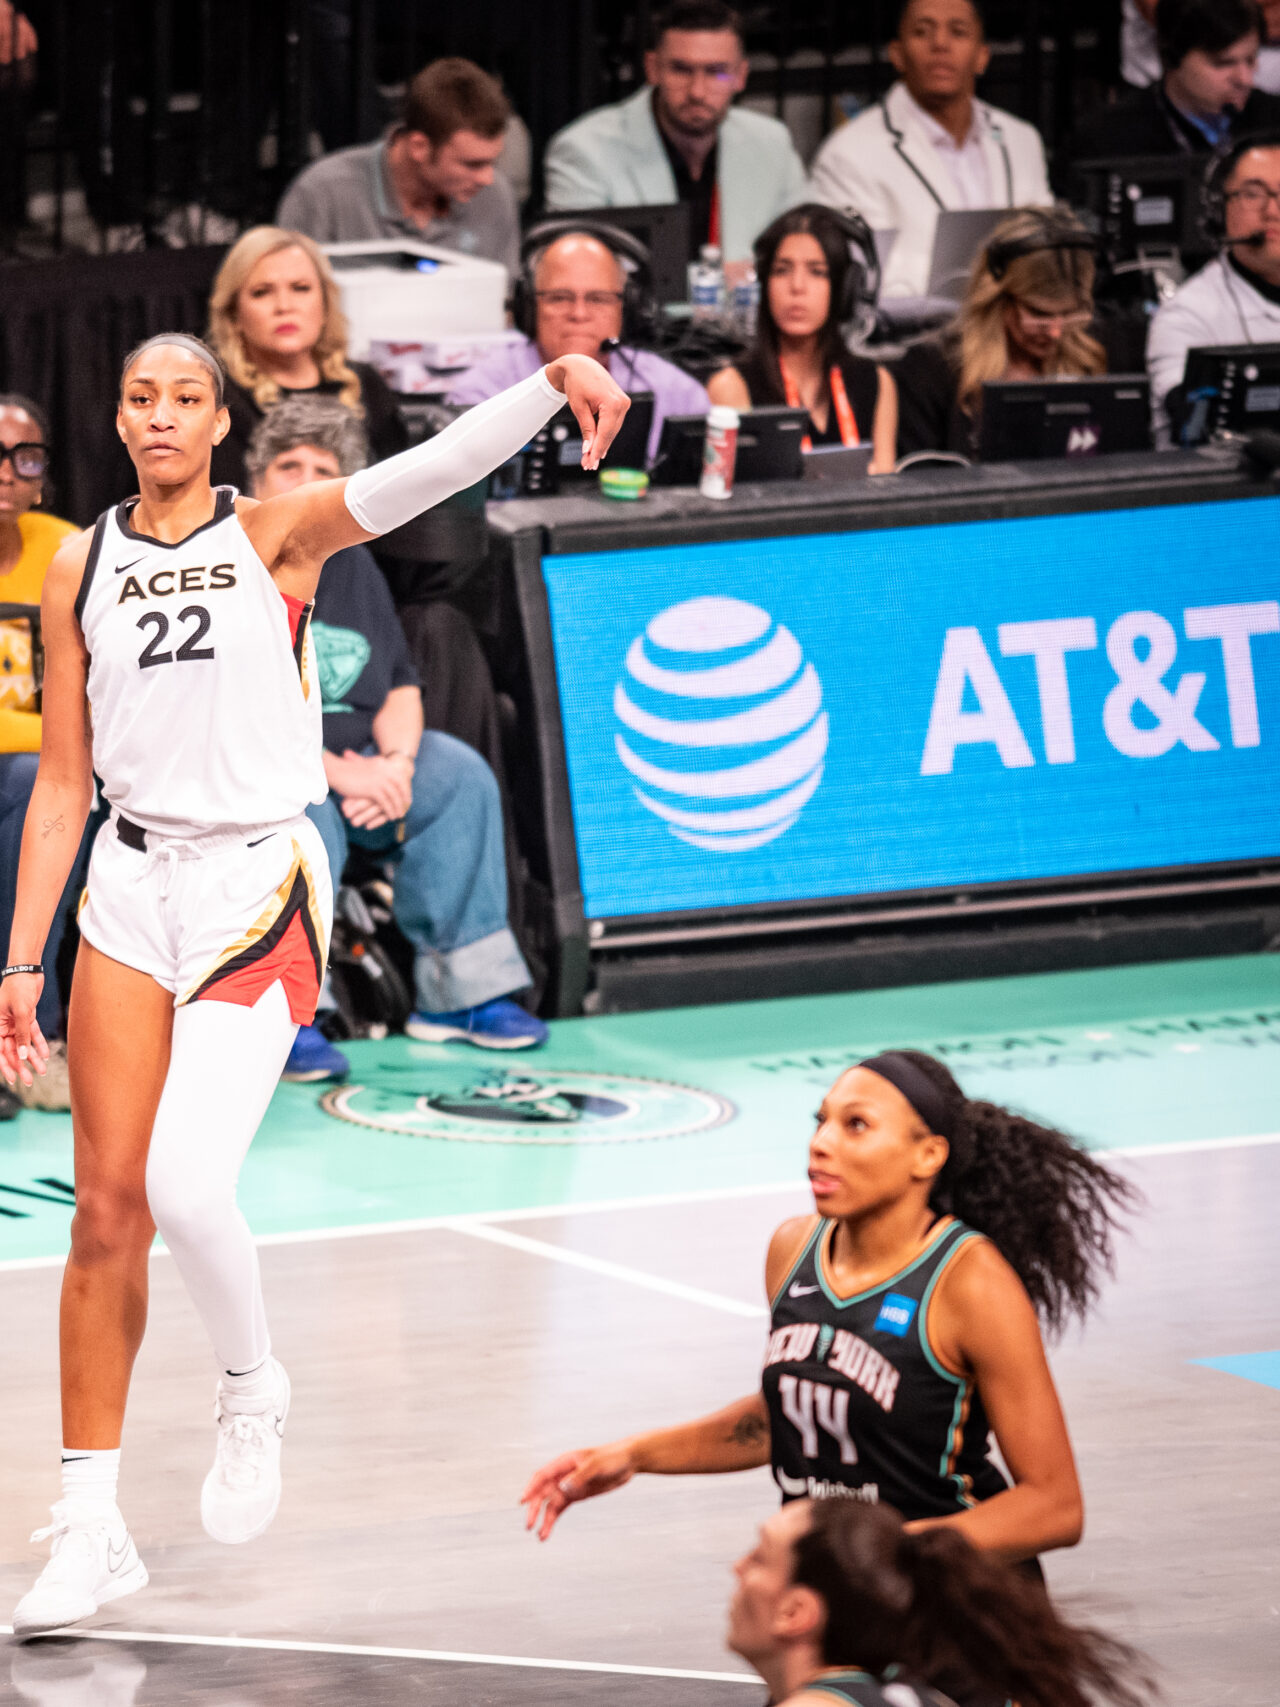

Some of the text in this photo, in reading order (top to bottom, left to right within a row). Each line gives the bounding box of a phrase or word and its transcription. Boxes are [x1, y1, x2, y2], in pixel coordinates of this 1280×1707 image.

[118, 563, 237, 604] ACES
[136, 605, 215, 669] 22
[919, 599, 1280, 776] AT&T
[778, 1373, 859, 1465] 44
